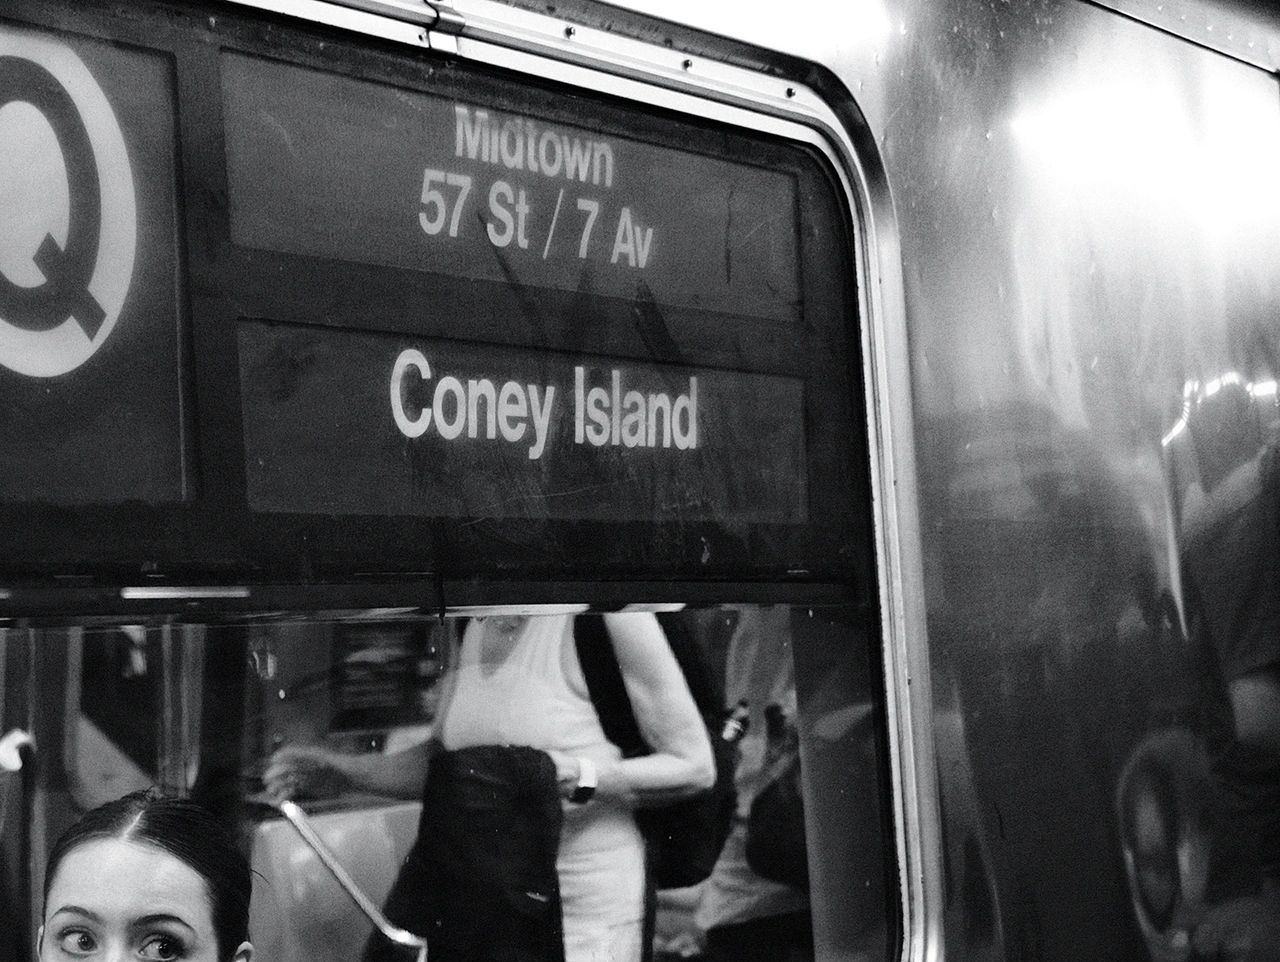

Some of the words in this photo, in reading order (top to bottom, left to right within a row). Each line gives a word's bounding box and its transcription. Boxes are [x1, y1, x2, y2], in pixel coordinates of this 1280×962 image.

[455, 104, 614, 188] Midtown
[418, 167, 472, 238] 57
[486, 179, 530, 250] St
[542, 187, 564, 260] /
[576, 197, 600, 260] 7
[609, 206, 654, 269] Av
[389, 348, 556, 461] Coney
[574, 365, 698, 451] Island
